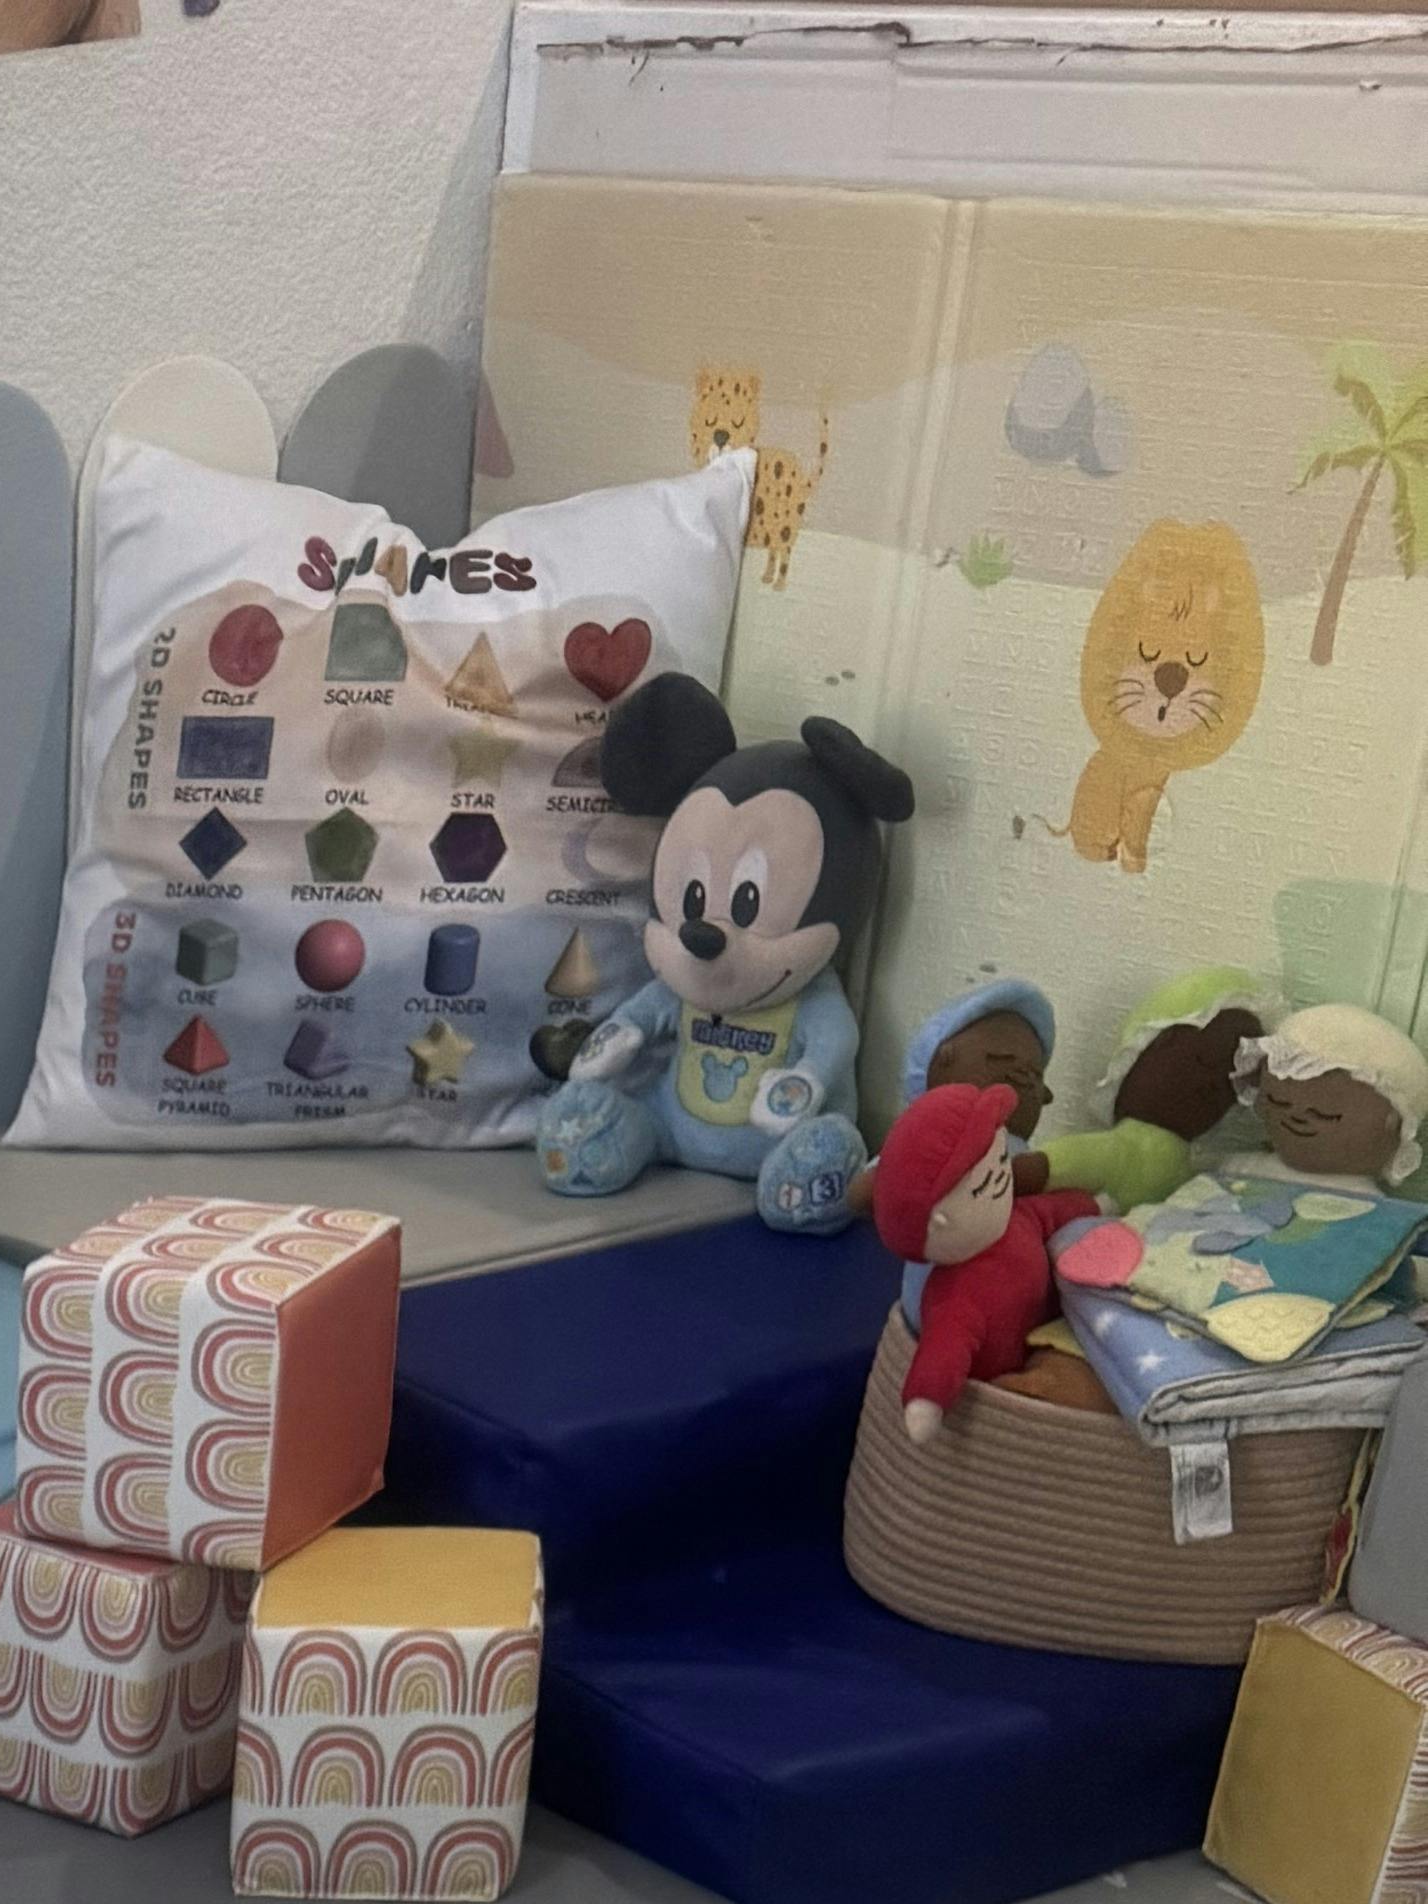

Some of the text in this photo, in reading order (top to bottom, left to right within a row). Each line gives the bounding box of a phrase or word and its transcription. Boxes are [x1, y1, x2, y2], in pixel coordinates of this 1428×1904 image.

[324, 688, 394, 706] SQUARE
[128, 627, 176, 809] 2D SHAPES
[174, 787, 264, 804] RECTANGLE
[325, 789, 369, 806] OVAL
[450, 792, 495, 809] STAR
[166, 882, 622, 906] DIAMOND PENTAGON HEXAGON CRESCENT
[96, 912, 137, 1088] 3D SHAPES
[295, 996, 356, 1012] SPHERE
[404, 998, 487, 1015] CYLINDER
[547, 1000, 591, 1015] CONE
[163, 1078, 226, 1094] SQUARE
[158, 1101, 230, 1117] PYRAMID
